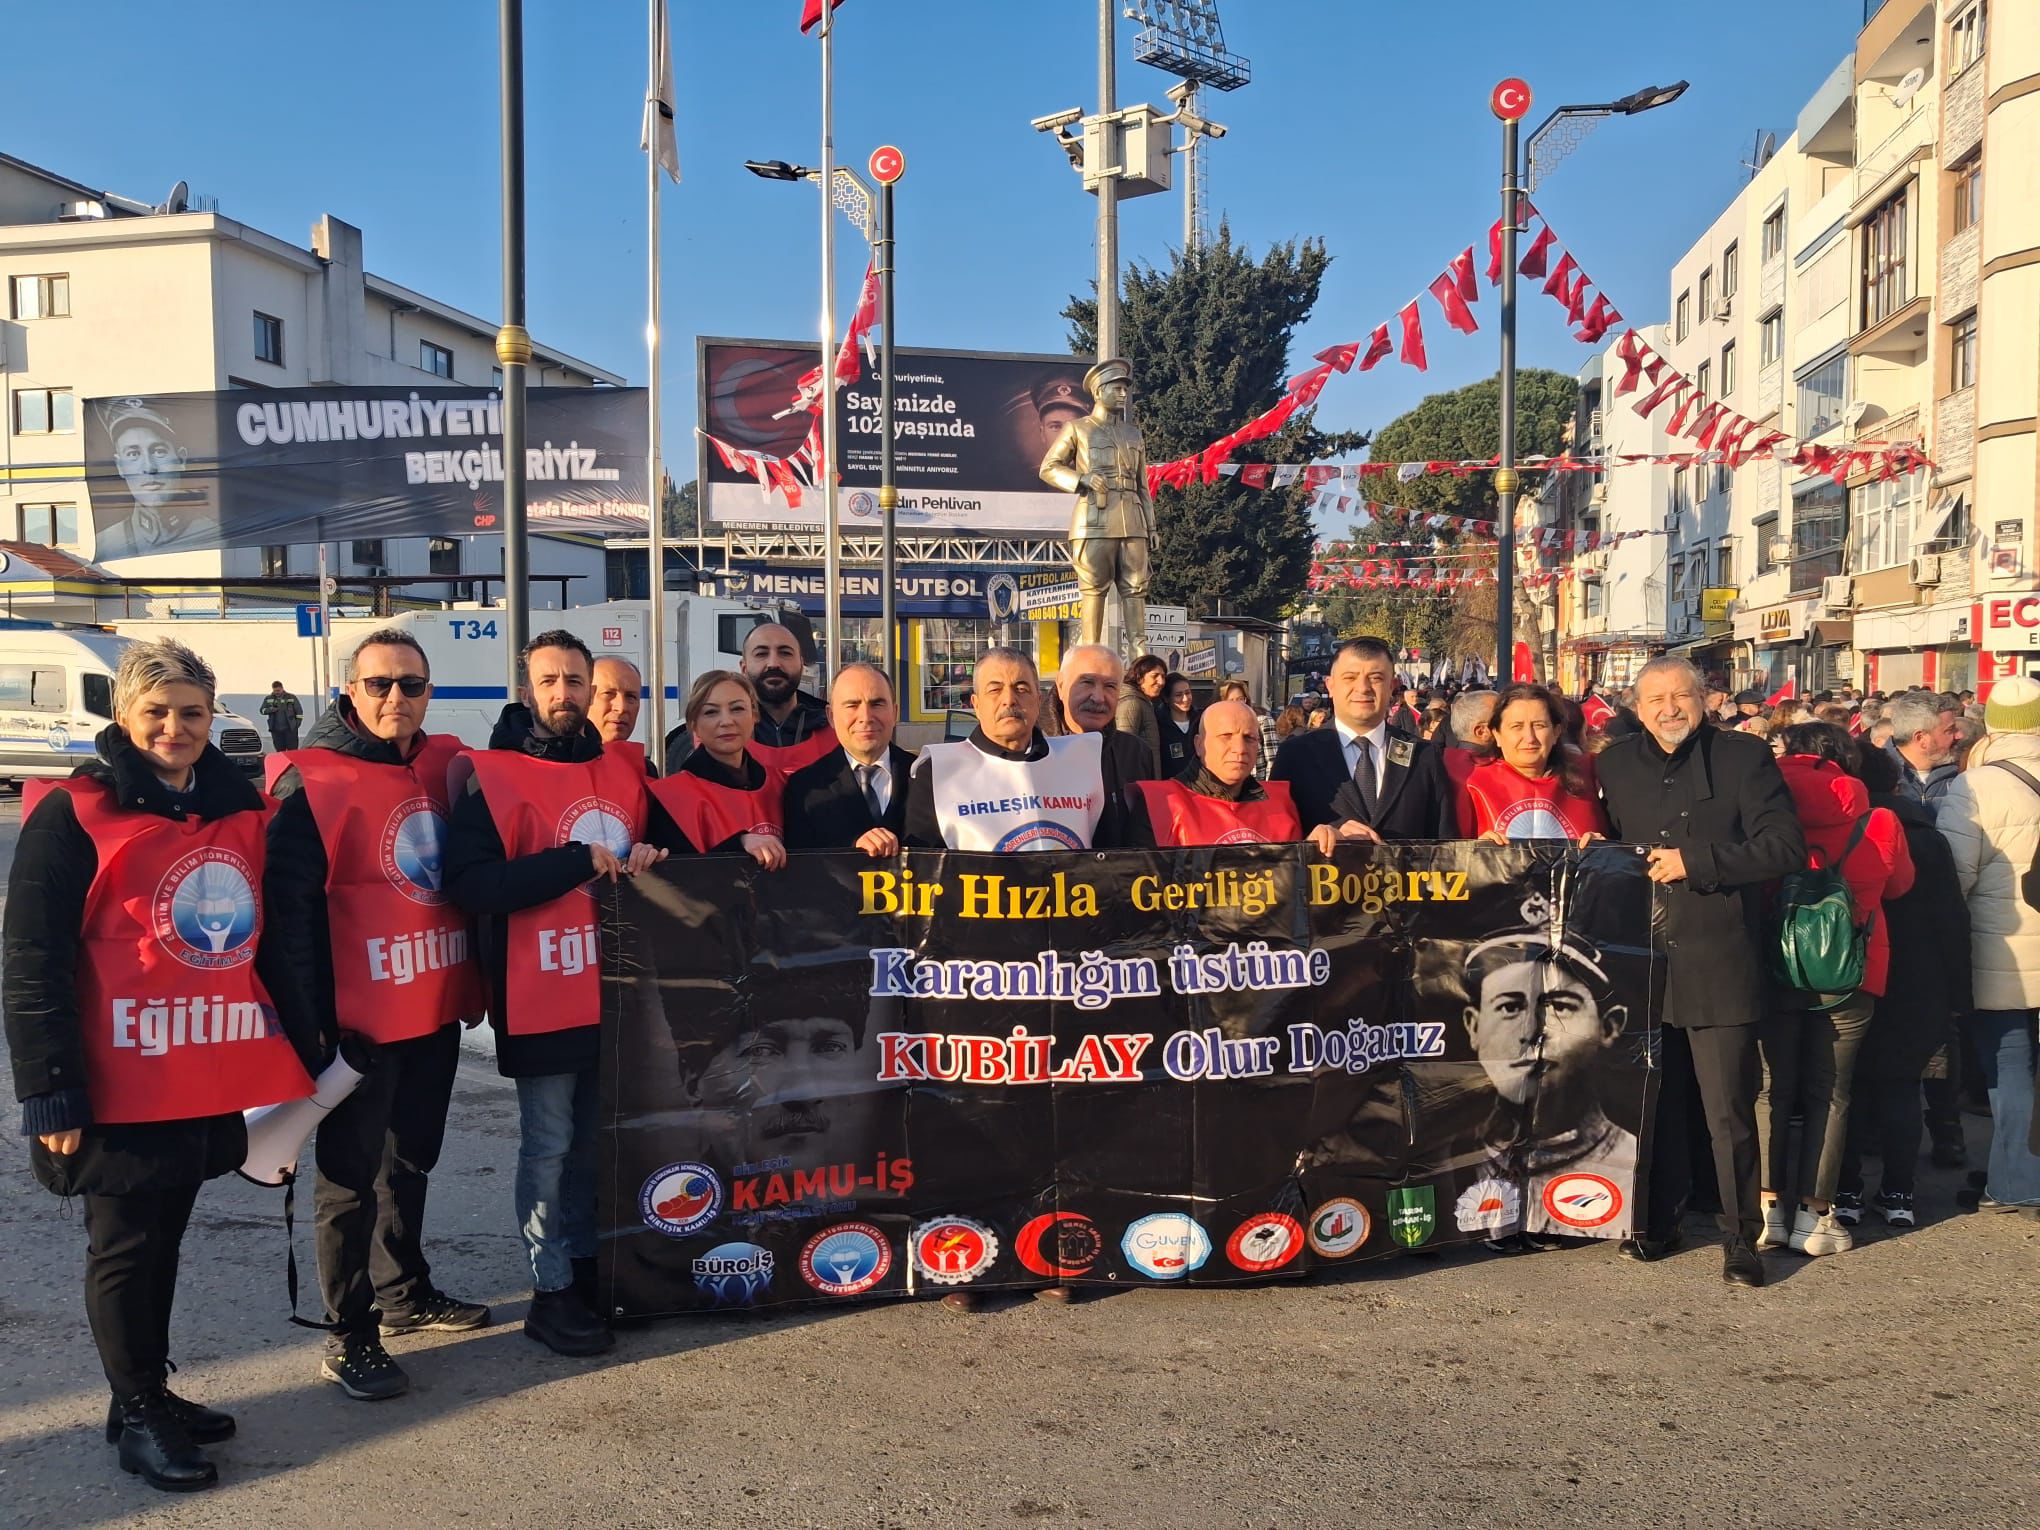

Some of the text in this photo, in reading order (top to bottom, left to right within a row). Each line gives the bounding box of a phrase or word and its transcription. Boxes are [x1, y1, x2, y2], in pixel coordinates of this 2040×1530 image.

[847, 392, 956, 415] Saynizde
[236, 392, 504, 446] CUMHURİYETİ
[893, 418, 975, 440] yaşında
[404, 440, 620, 490] BEKÇİLRİYİZ...
[526, 502, 560, 517] stafa
[561, 502, 600, 517] Kemal
[921, 496, 982, 511] Pehlivan
[473, 514, 497, 528] CHP
[722, 521, 824, 533] MENEMEN BELEDİYESİ
[753, 574, 879, 596] MENEEN
[1019, 572, 1059, 590] FUTBOL
[1042, 606, 1057, 620] 640
[1058, 603, 1069, 618] 19
[1145, 612, 1175, 623] mir
[449, 620, 498, 640] T34
[604, 628, 620, 639] 112
[957, 793, 1042, 816] BİRLEŞİK
[161, 884, 174, 899] VE
[170, 857, 198, 884] BİLİM
[858, 863, 1471, 919] Bir Hızla Geriliği Boğarız
[366, 926, 468, 985] Eğitim
[538, 923, 598, 976] Eği
[869, 941, 1330, 1008] Karanlığın üstüne
[112, 995, 265, 1057] Eğitim
[877, 1017, 1446, 1085] KUBİLAY Olur Doğarız
[732, 1151, 915, 1212] KAMU-İŞ
[692, 1250, 775, 1275] BÜRO-İŞ
